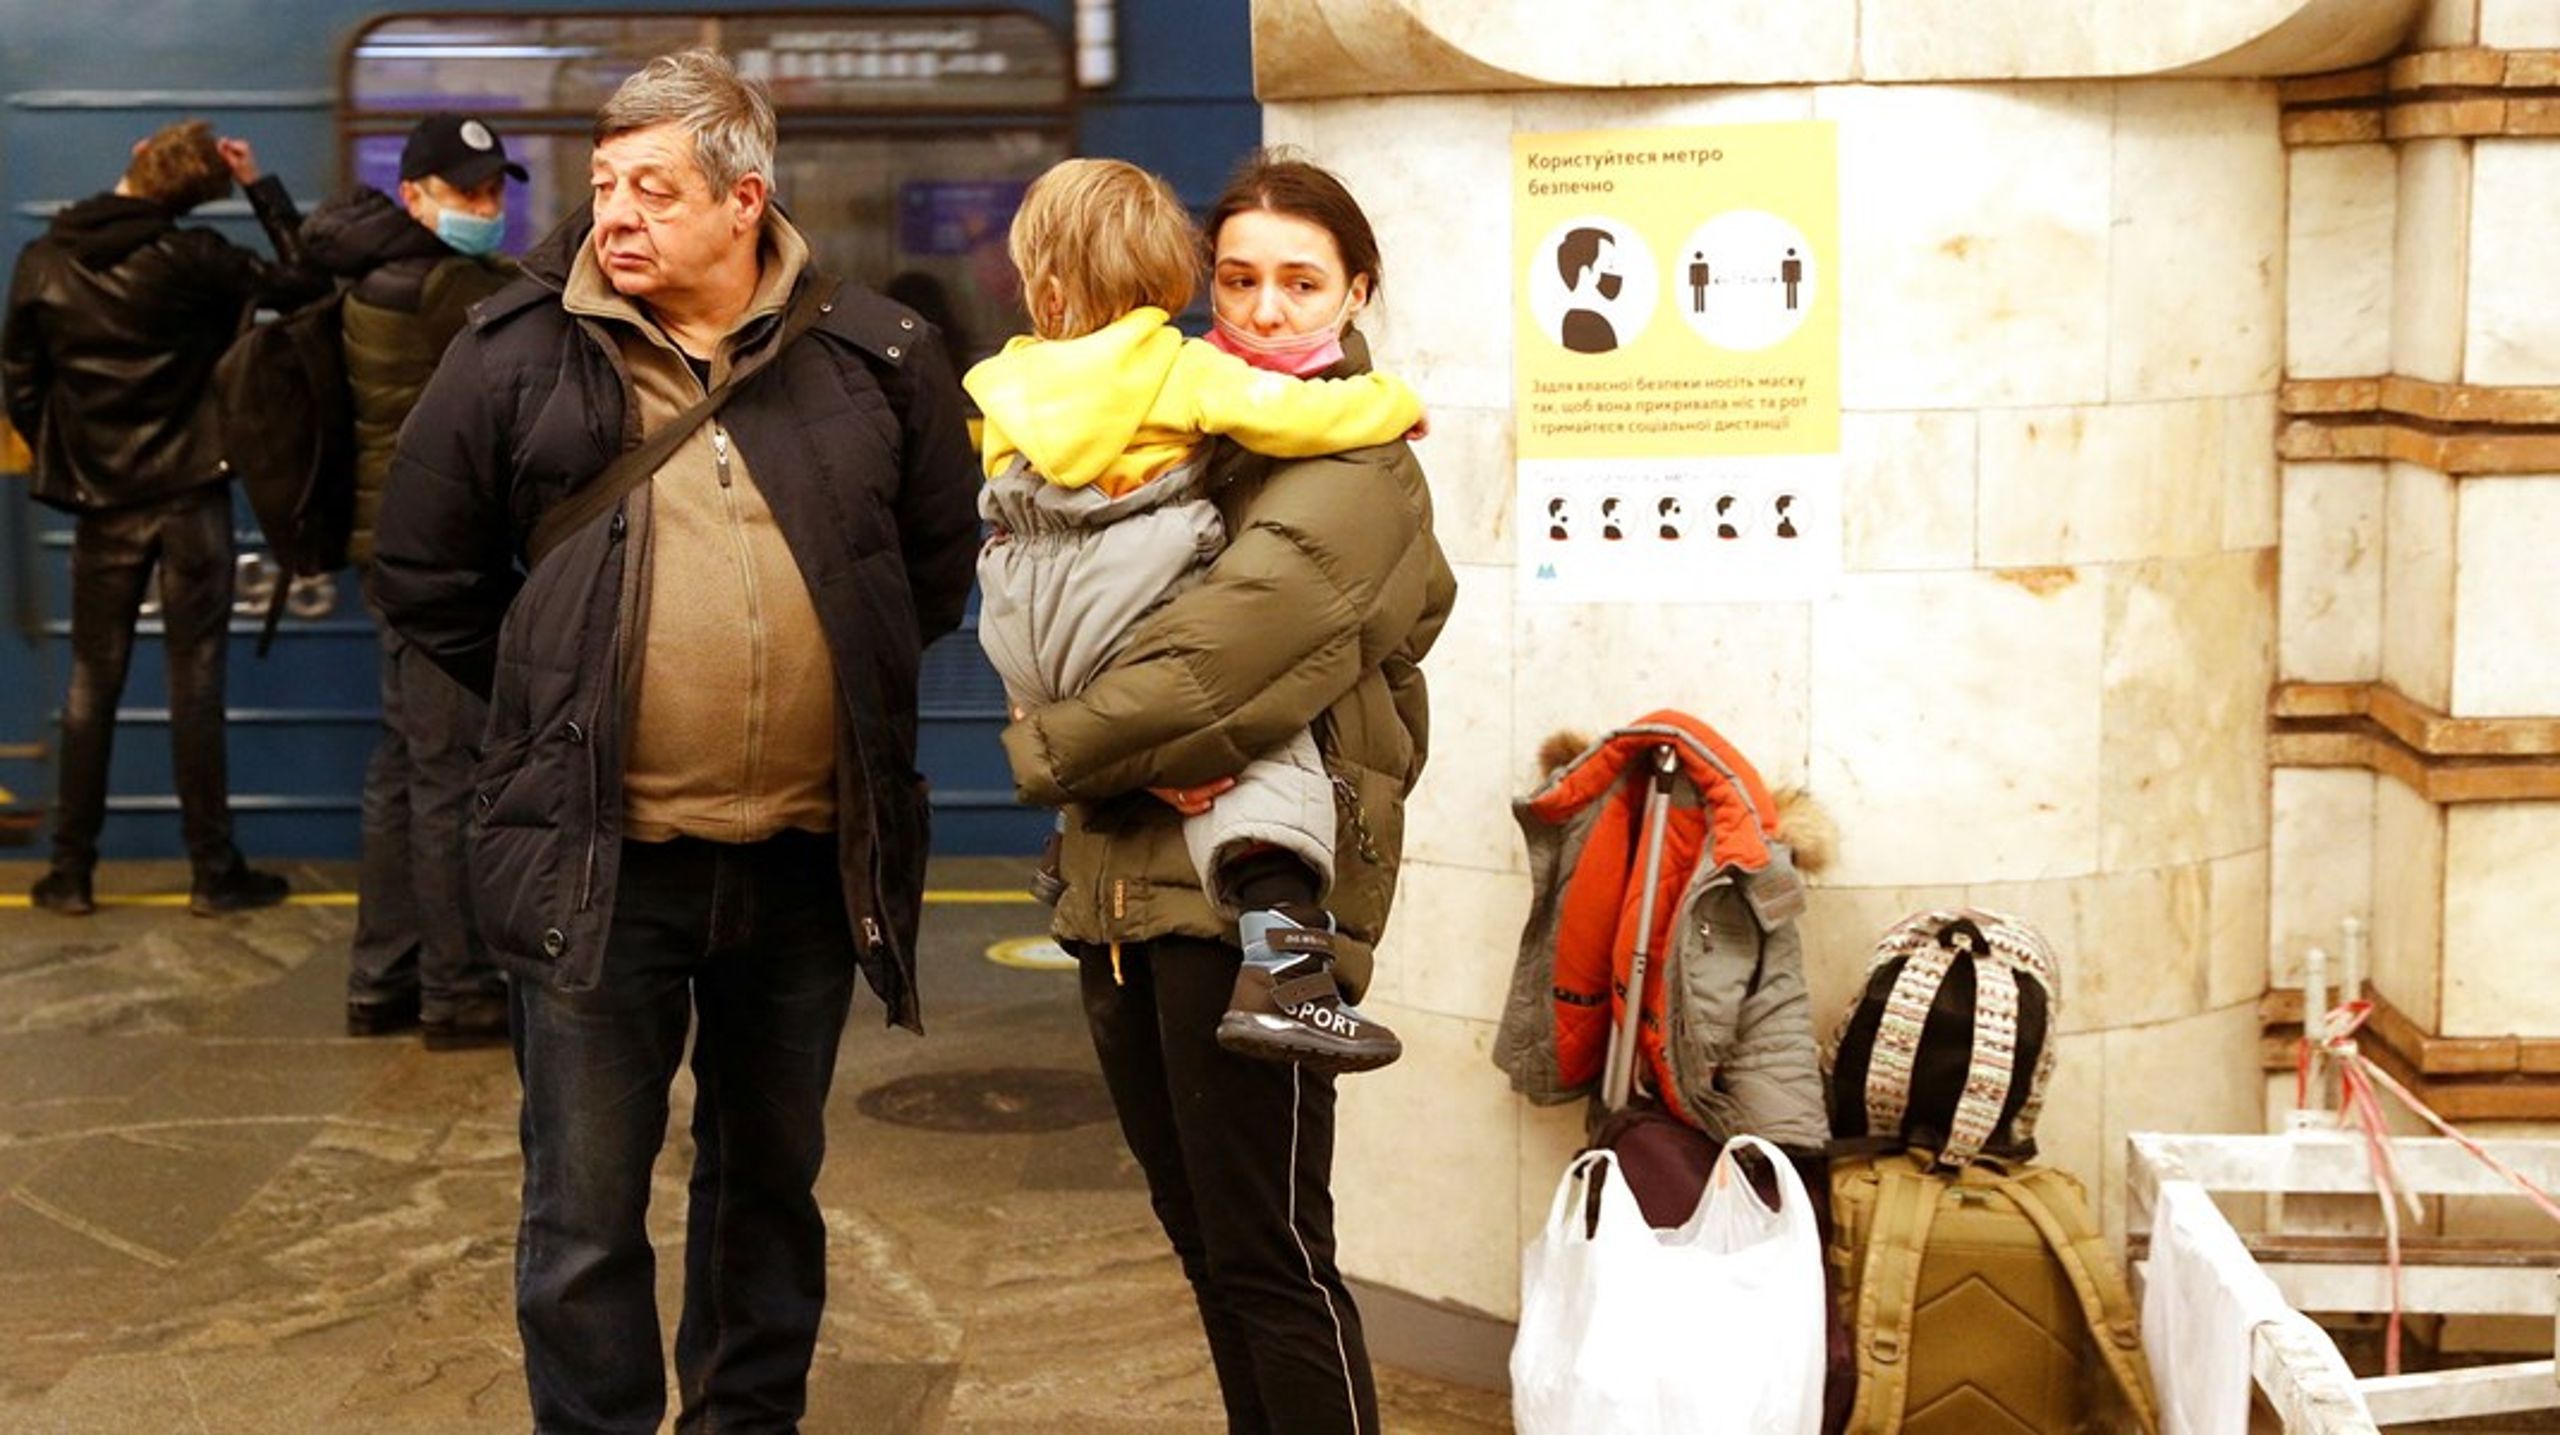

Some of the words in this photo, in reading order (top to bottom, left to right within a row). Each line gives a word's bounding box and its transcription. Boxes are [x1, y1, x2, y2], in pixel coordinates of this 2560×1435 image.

[1527, 149, 1657, 173] Користуйтеся
[1662, 148, 1724, 167] метро
[1527, 179, 1615, 197] безпечно
[1636, 377, 1700, 392] безпеки
[1758, 376, 1805, 390] маску
[1597, 402, 1631, 413] вона
[1636, 399, 1728, 415] прикривала
[1779, 397, 1807, 412] рот
